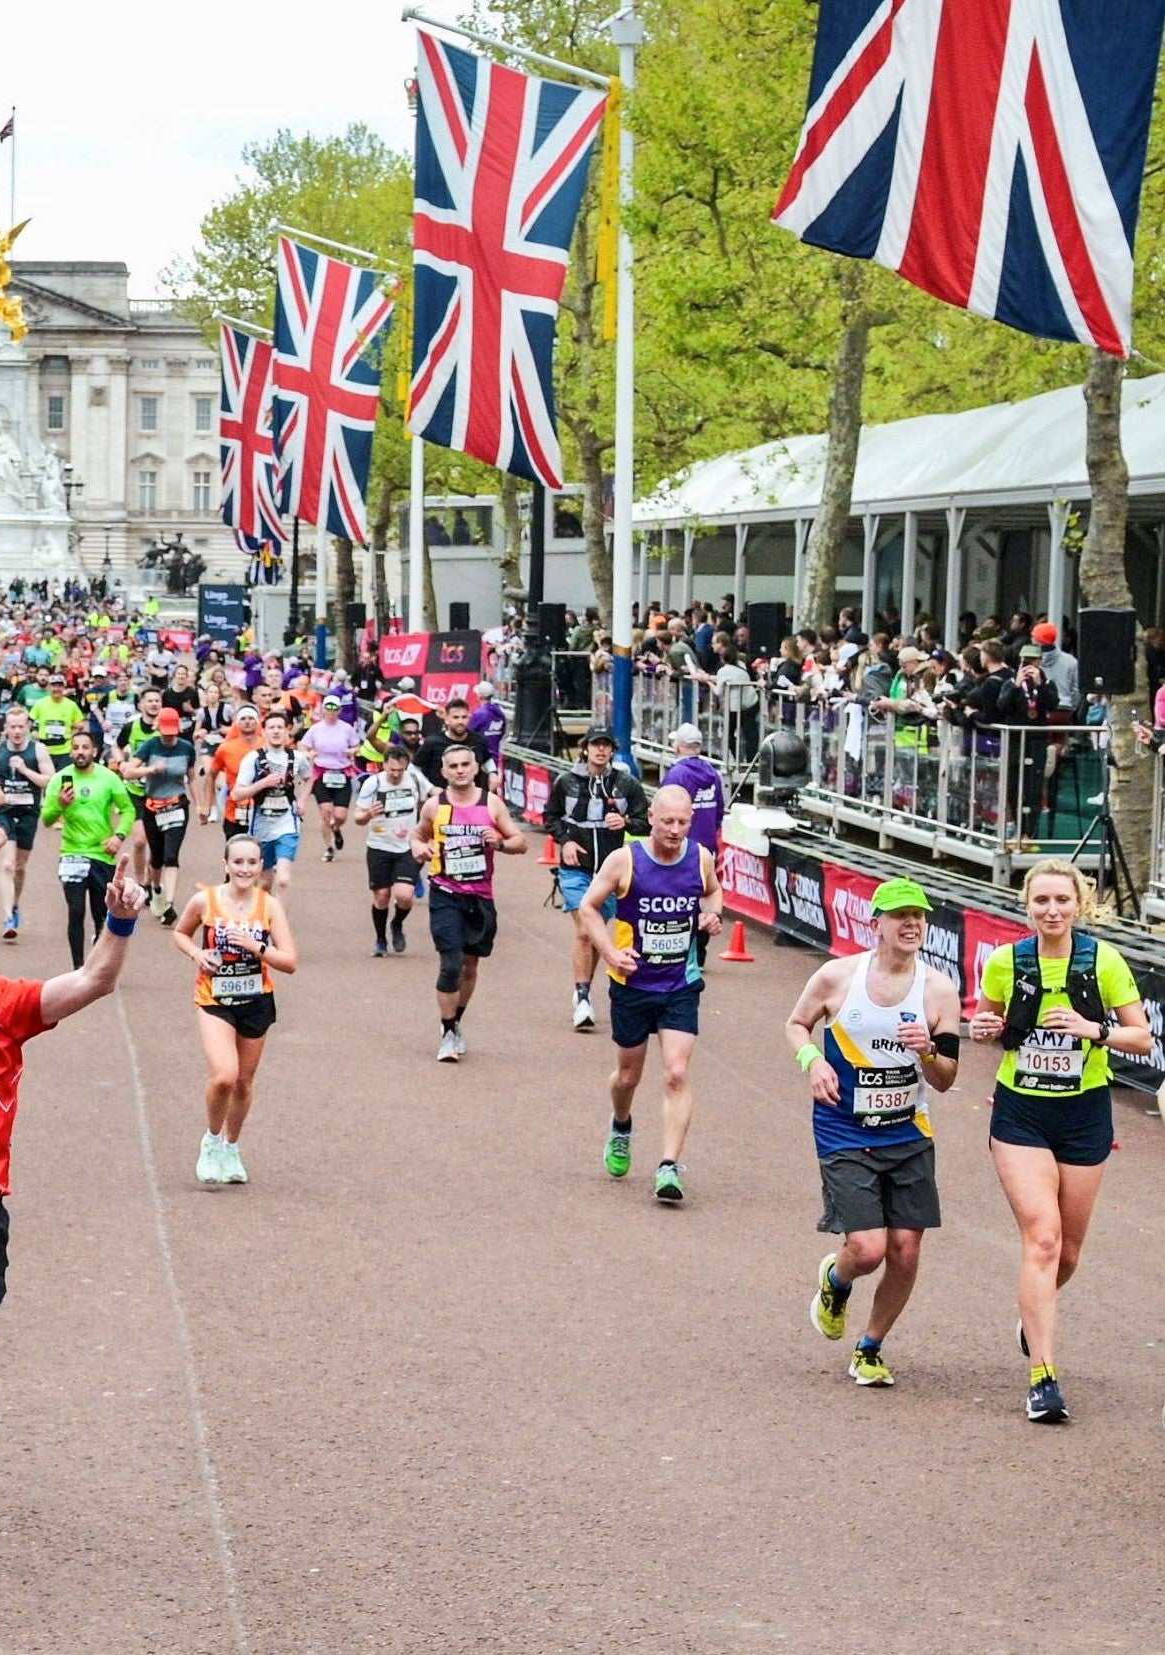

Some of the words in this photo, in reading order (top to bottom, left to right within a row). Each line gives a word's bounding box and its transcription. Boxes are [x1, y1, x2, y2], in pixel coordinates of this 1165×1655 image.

[440, 642, 465, 663] tcs
[639, 896, 697, 913] SCOPE
[647, 920, 666, 933] tcs
[651, 937, 684, 950] 56055
[923, 922, 959, 963] LONDON
[220, 979, 255, 992] 59619
[871, 1038, 906, 1053] BRYN
[1029, 1029, 1066, 1047] AMY
[1026, 1053, 1071, 1072] 10153
[859, 1069, 883, 1086] tcs
[866, 1091, 911, 1109] 15387
